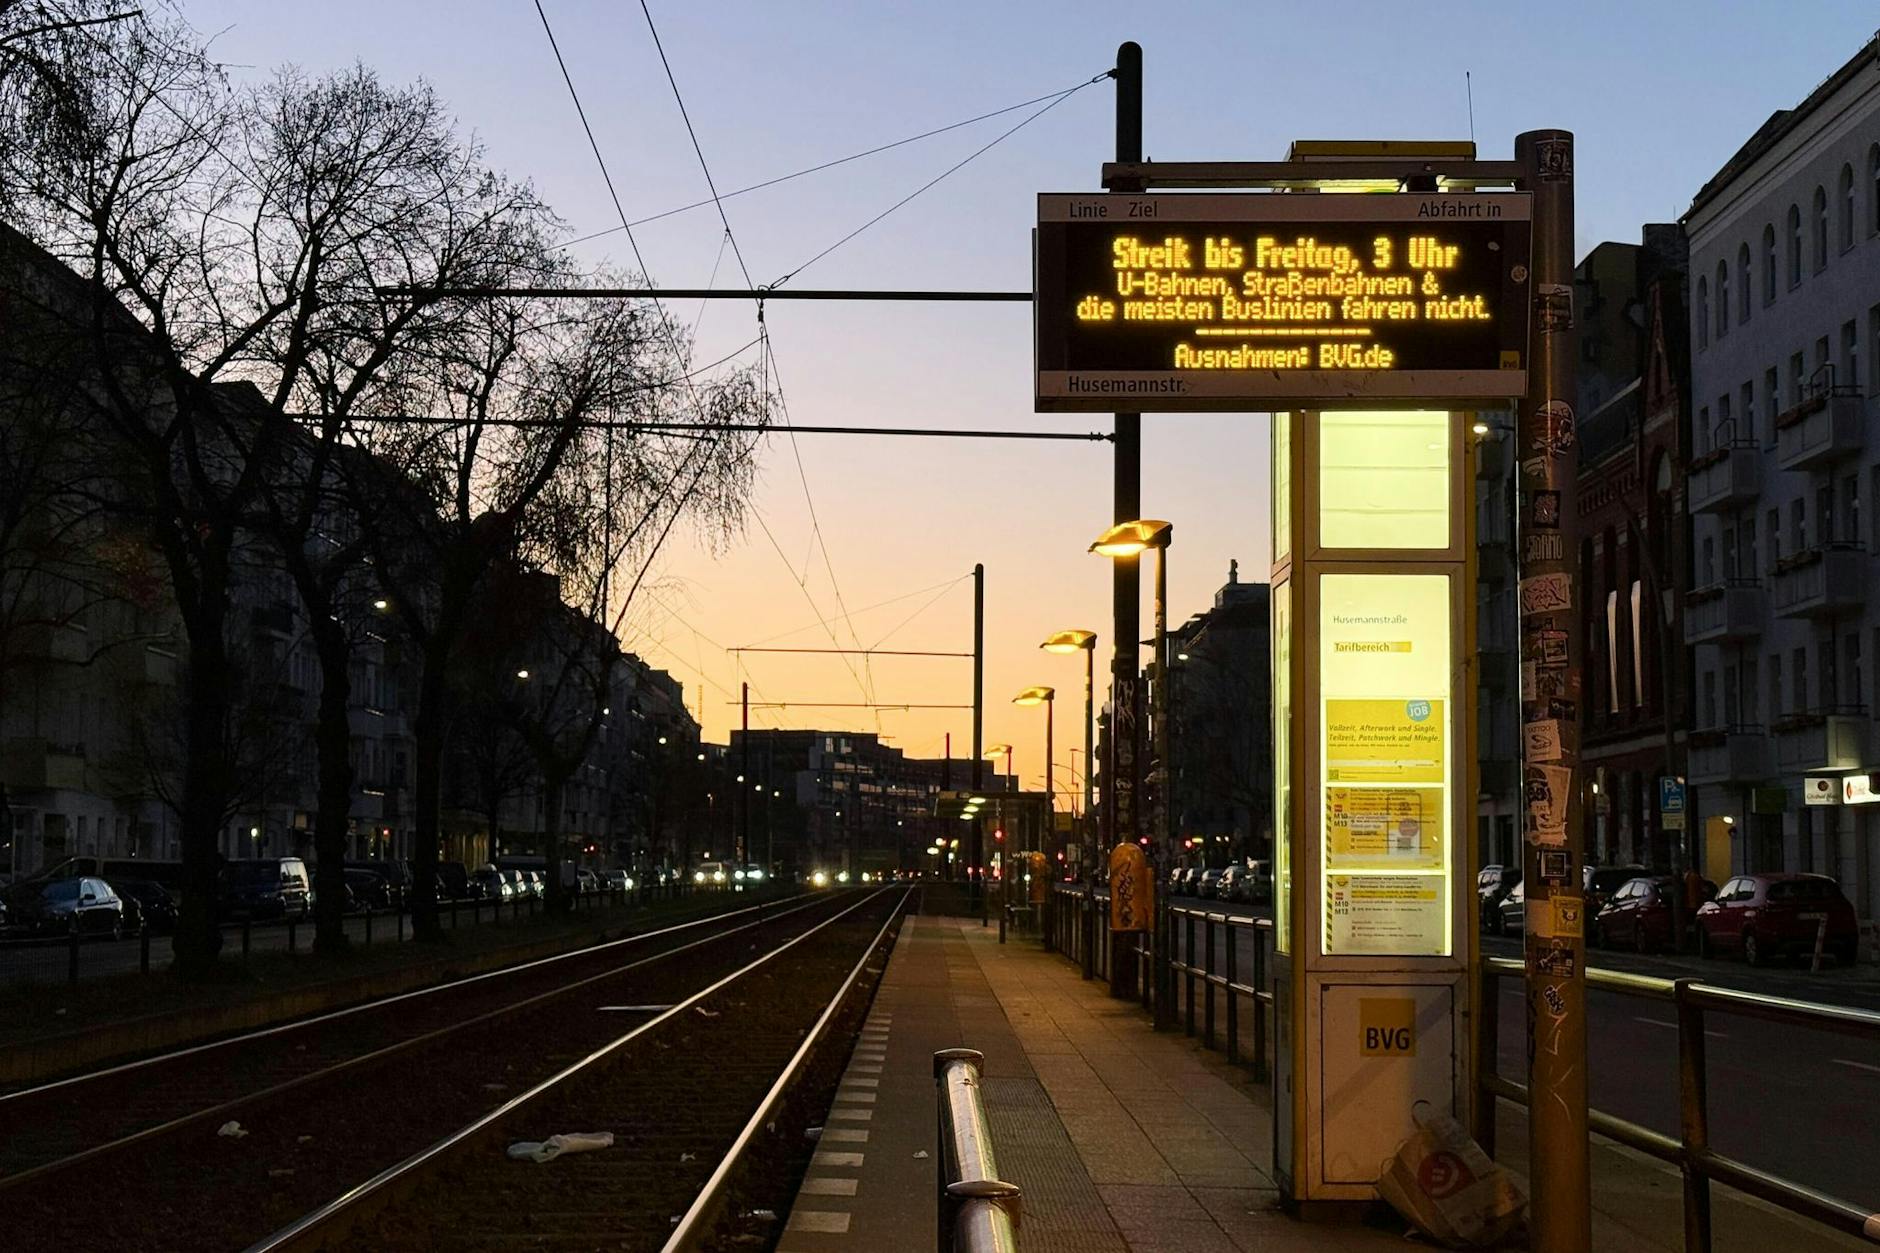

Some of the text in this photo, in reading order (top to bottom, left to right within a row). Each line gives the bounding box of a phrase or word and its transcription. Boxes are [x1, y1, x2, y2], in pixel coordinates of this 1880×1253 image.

[1070, 202, 1158, 218] Linie Ziel
[1418, 202, 1501, 218] Abfahrt in
[1113, 237, 1458, 273] Streik bis Freitag, 3 Uhr
[1117, 273, 1439, 298] U-Bahnen, Straßenbahnen &
[1077, 297, 1490, 320] die meisten Buslinien fahren nicht.
[1175, 344, 1394, 368] Ausnahmen: BVG.de
[1069, 375, 1186, 393] Husemannstr.
[1333, 615, 1408, 625] Husemannstraße
[1335, 642, 1390, 652] Tarifbereich
[1409, 706, 1429, 717] JOB
[1360, 724, 1395, 732] Afterwork
[1398, 724, 1411, 732] und
[1329, 734, 1356, 742] Teilzeit,
[1359, 734, 1396, 742] Patchwork
[1399, 734, 1412, 742] und
[1366, 1027, 1410, 1050] BVG
